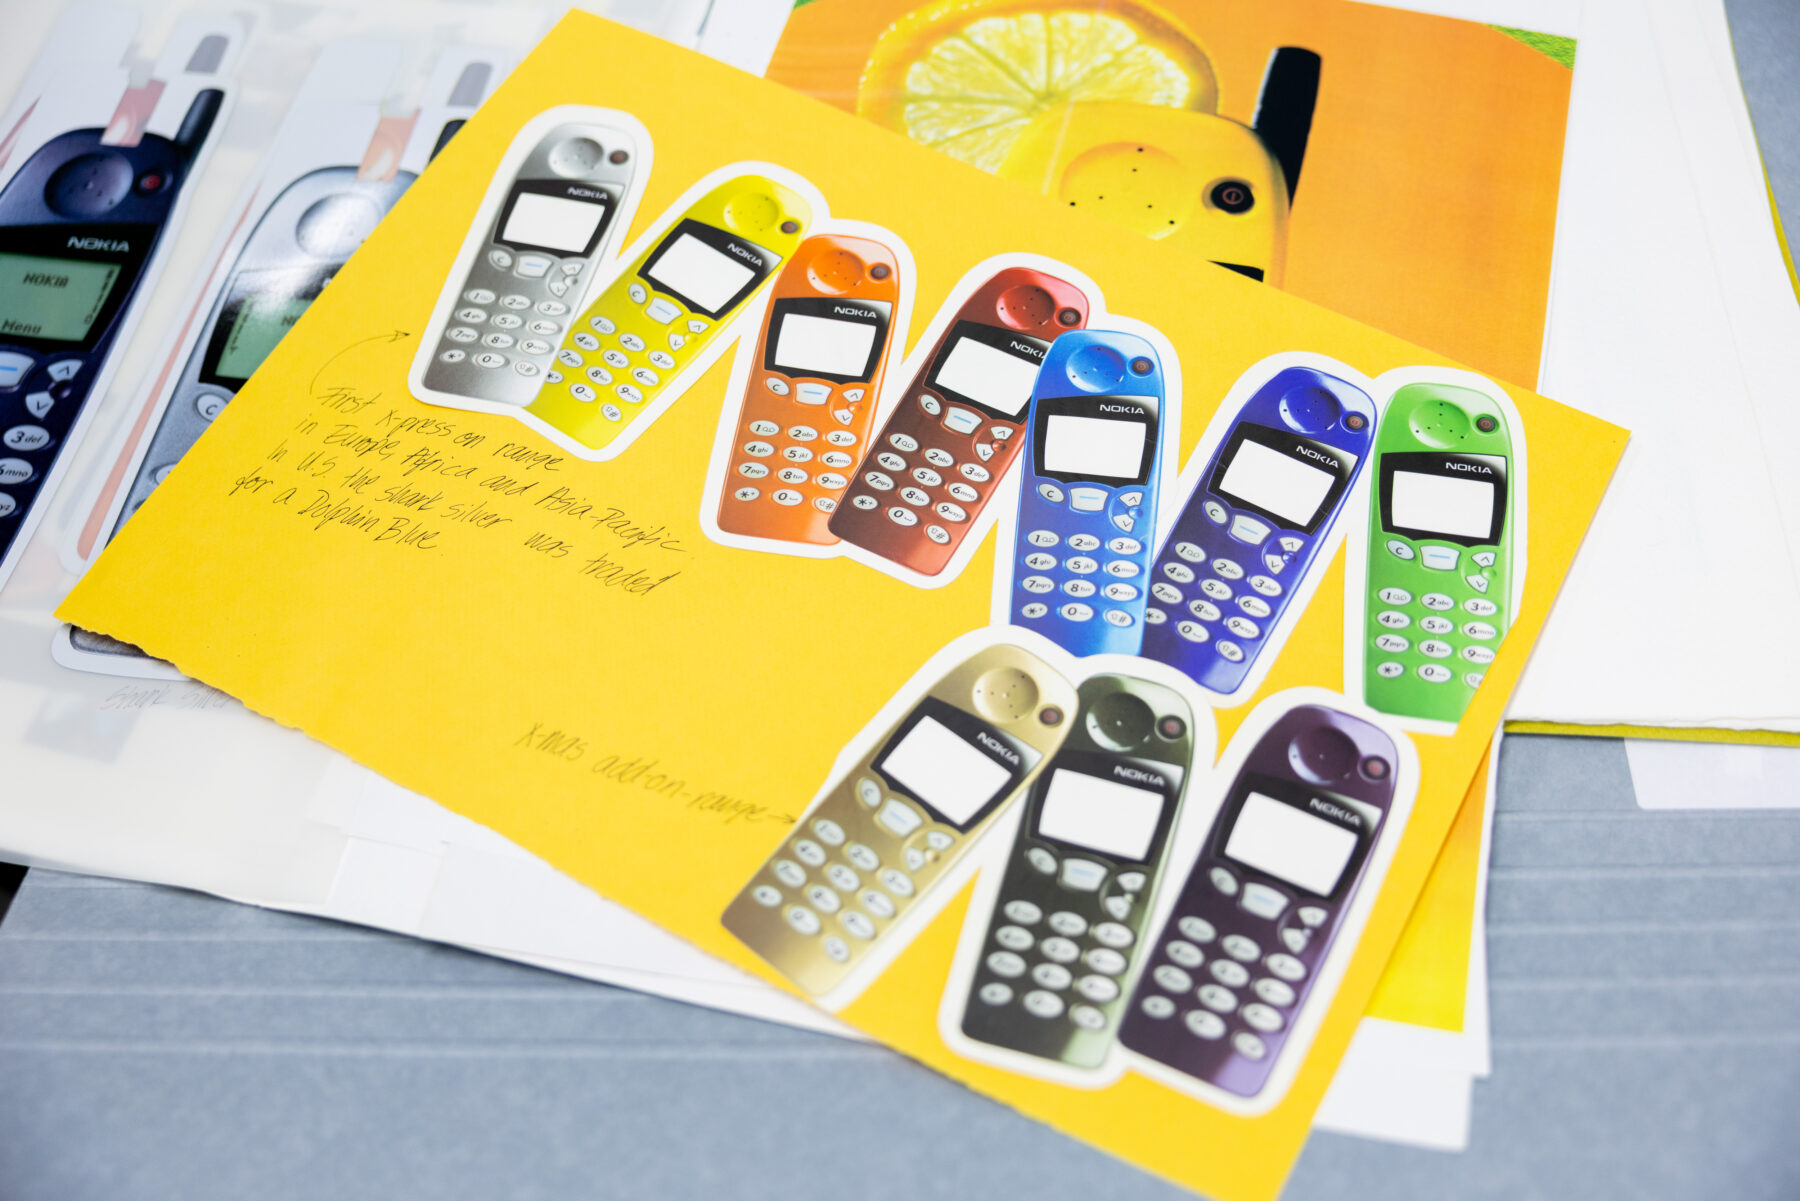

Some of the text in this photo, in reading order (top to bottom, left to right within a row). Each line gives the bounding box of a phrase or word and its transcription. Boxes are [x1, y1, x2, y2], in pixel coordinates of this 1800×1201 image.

[567, 187, 608, 200] NOKIA
[67, 236, 130, 252] NOKIA
[727, 243, 763, 267] NOKIA
[23, 272, 69, 288] NOKIA
[834, 305, 877, 319] NOKIA
[2, 318, 42, 334] Menu
[1099, 404, 1145, 415] NOKIA
[317, 387, 382, 414] First
[453, 432, 486, 448] on
[493, 442, 564, 471] range
[295, 413, 318, 434] in
[400, 446, 478, 477] Africa
[479, 475, 540, 496] and
[1296, 445, 1340, 469] NOKIA
[1445, 462, 1492, 475] NOKIA
[229, 467, 274, 496] for
[273, 488, 298, 505] a
[297, 489, 380, 532] Dolphin
[340, 467, 381, 494] the
[524, 532, 573, 558] was
[578, 553, 682, 596] traded
[976, 732, 1020, 766] NOKIA
[1113, 765, 1166, 787] NOKIA
[1309, 798, 1363, 826] NOKIA
